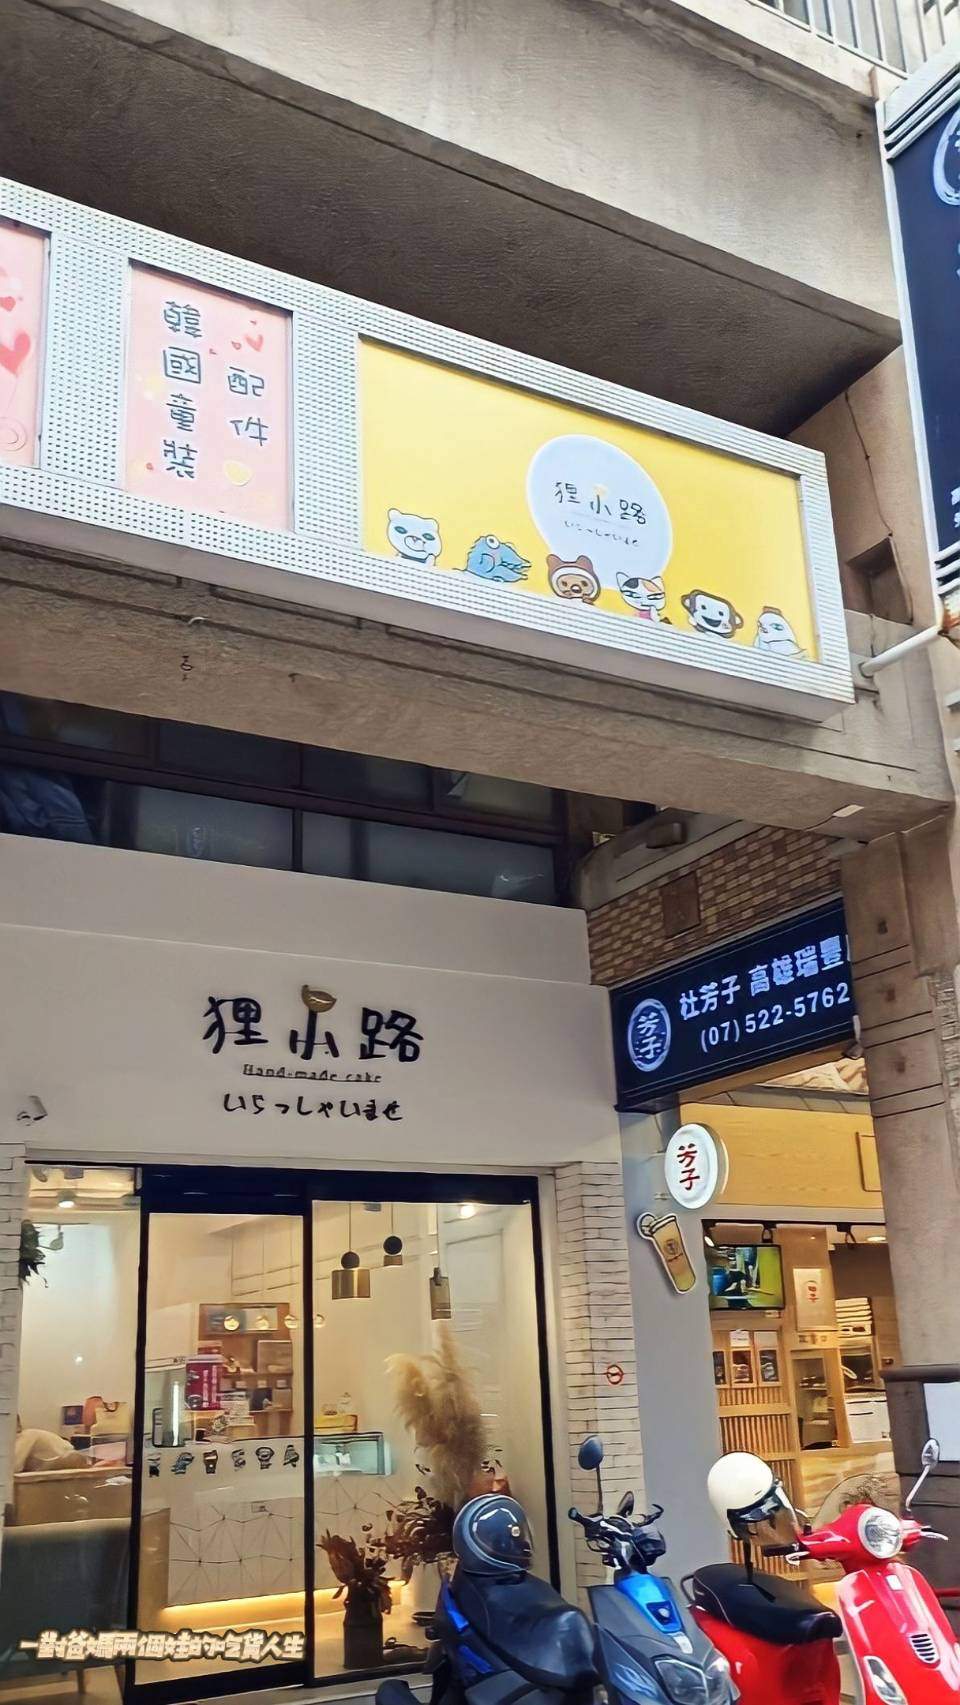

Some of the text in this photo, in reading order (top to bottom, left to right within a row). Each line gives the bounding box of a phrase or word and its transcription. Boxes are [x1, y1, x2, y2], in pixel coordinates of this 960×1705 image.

[163, 300, 202, 480] 韓國童裝
[227, 366, 269, 447] 配件
[554, 482, 646, 525] 狸小路
[748, 934, 849, 998] 高雄瑞豐
[203, 985, 424, 1062] 狸小路
[637, 1012, 661, 1059] 芳子
[701, 982, 850, 1052] (07) 522-5762
[242, 1064, 382, 1083] Hand-made cake
[223, 1093, 403, 1121] いらっしゃいませ
[676, 1143, 700, 1191] 芳子
